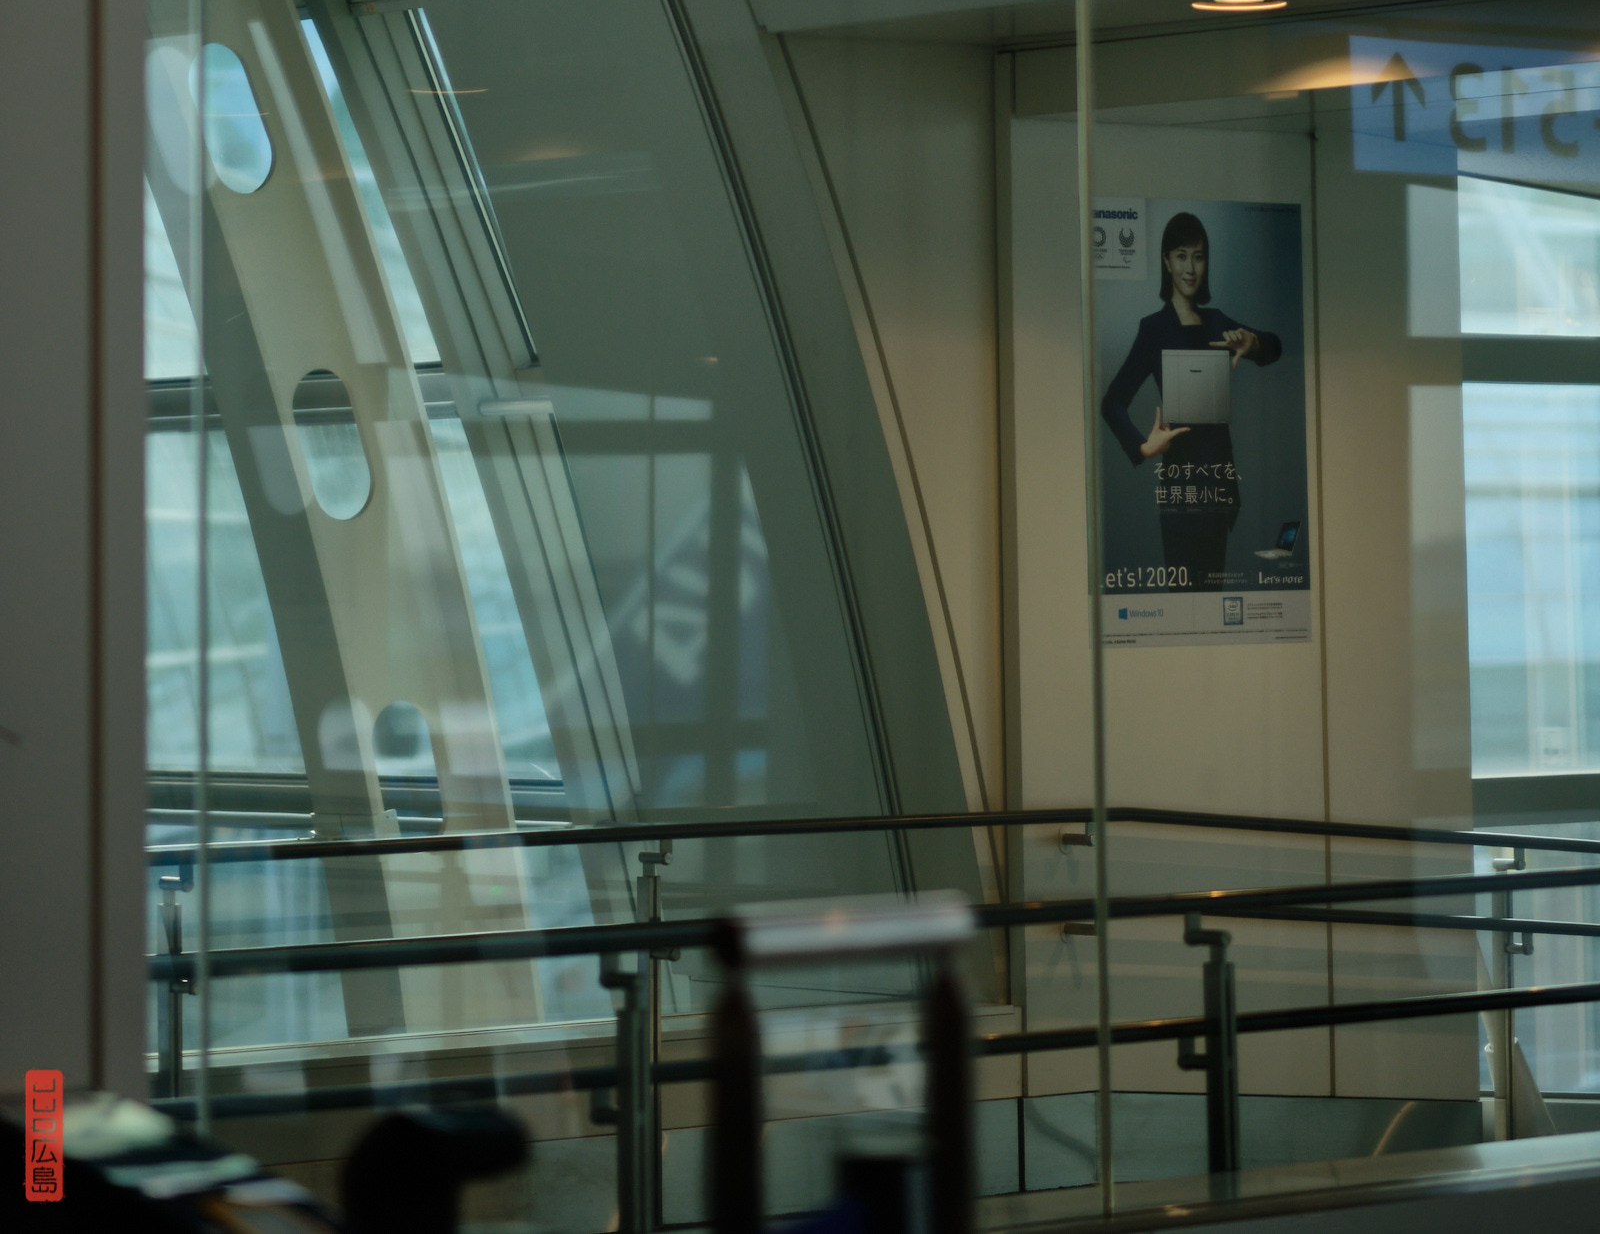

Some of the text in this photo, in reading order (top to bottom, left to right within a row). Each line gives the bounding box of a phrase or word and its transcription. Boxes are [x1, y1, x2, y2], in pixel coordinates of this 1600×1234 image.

[1092, 208, 1138, 220] anasonic
[1154, 462, 1242, 481] そのすべてを、
[1154, 485, 1233, 504] 世界最小に。
[1100, 566, 1192, 588] et's! 2020.
[1280, 575, 1303, 584] note
[1129, 609, 1157, 618] Windows
